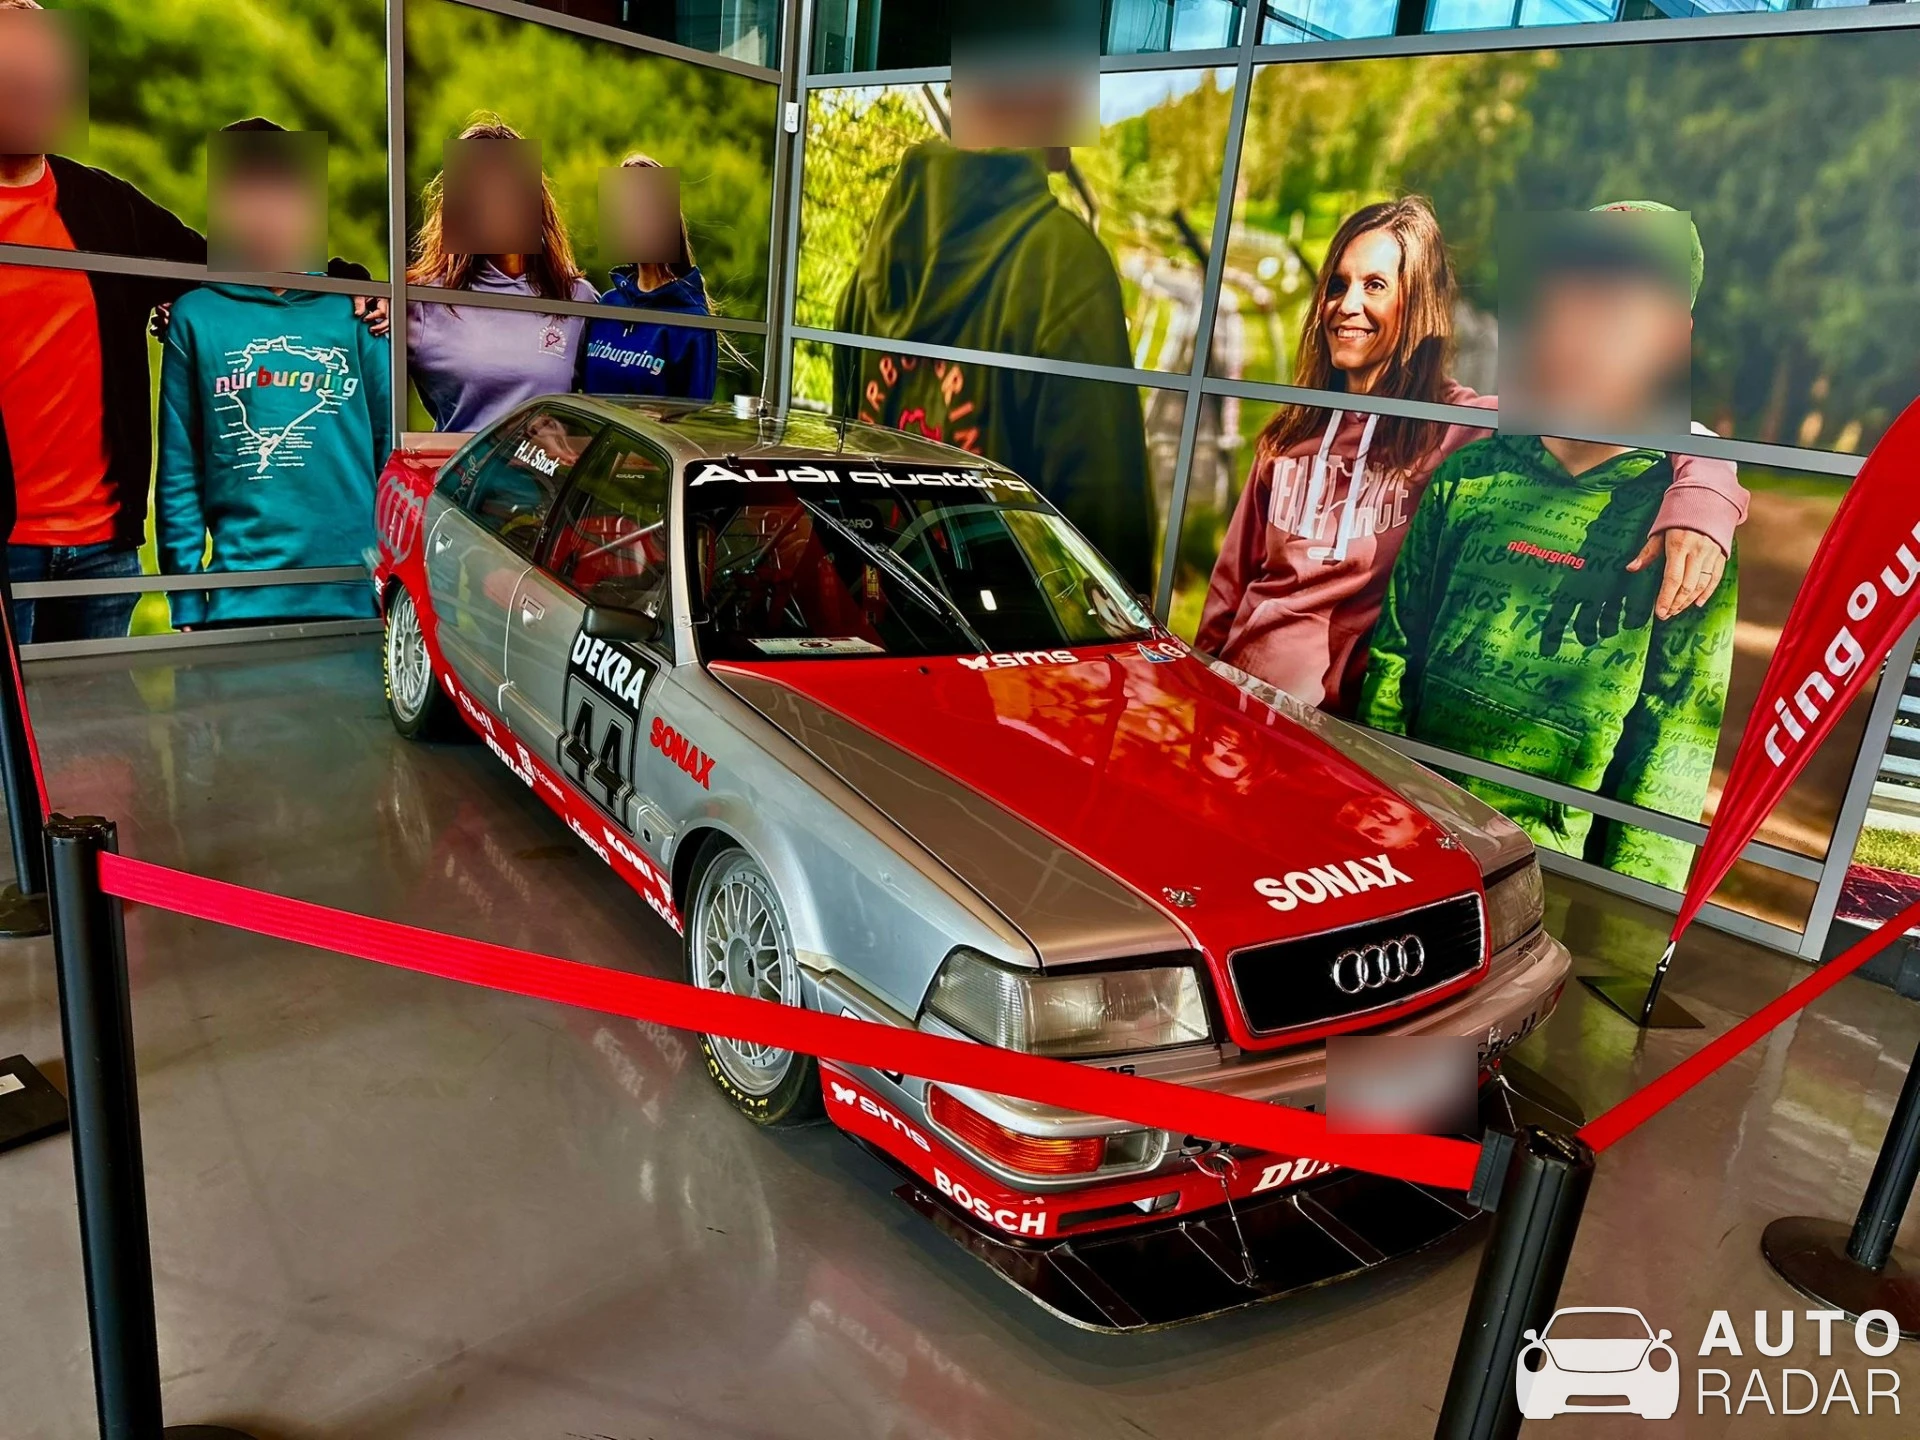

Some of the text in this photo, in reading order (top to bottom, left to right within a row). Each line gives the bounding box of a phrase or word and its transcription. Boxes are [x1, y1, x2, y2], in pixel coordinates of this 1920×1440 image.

[215, 366, 358, 397] nürburgring
[689, 464, 1031, 492] Audi quattro
[1507, 541, 1585, 570] nürburgring
[571, 630, 646, 709] DEKRA
[990, 650, 1079, 666] sms
[485, 733, 534, 788] DUNLOP
[565, 697, 625, 815] 44
[650, 716, 716, 791] SONAX
[603, 826, 654, 883] KONI
[1253, 853, 1414, 911] SONAX
[643, 887, 684, 938] BOSC
[860, 1095, 931, 1152] sms
[934, 1167, 1046, 1235] BOSCH
